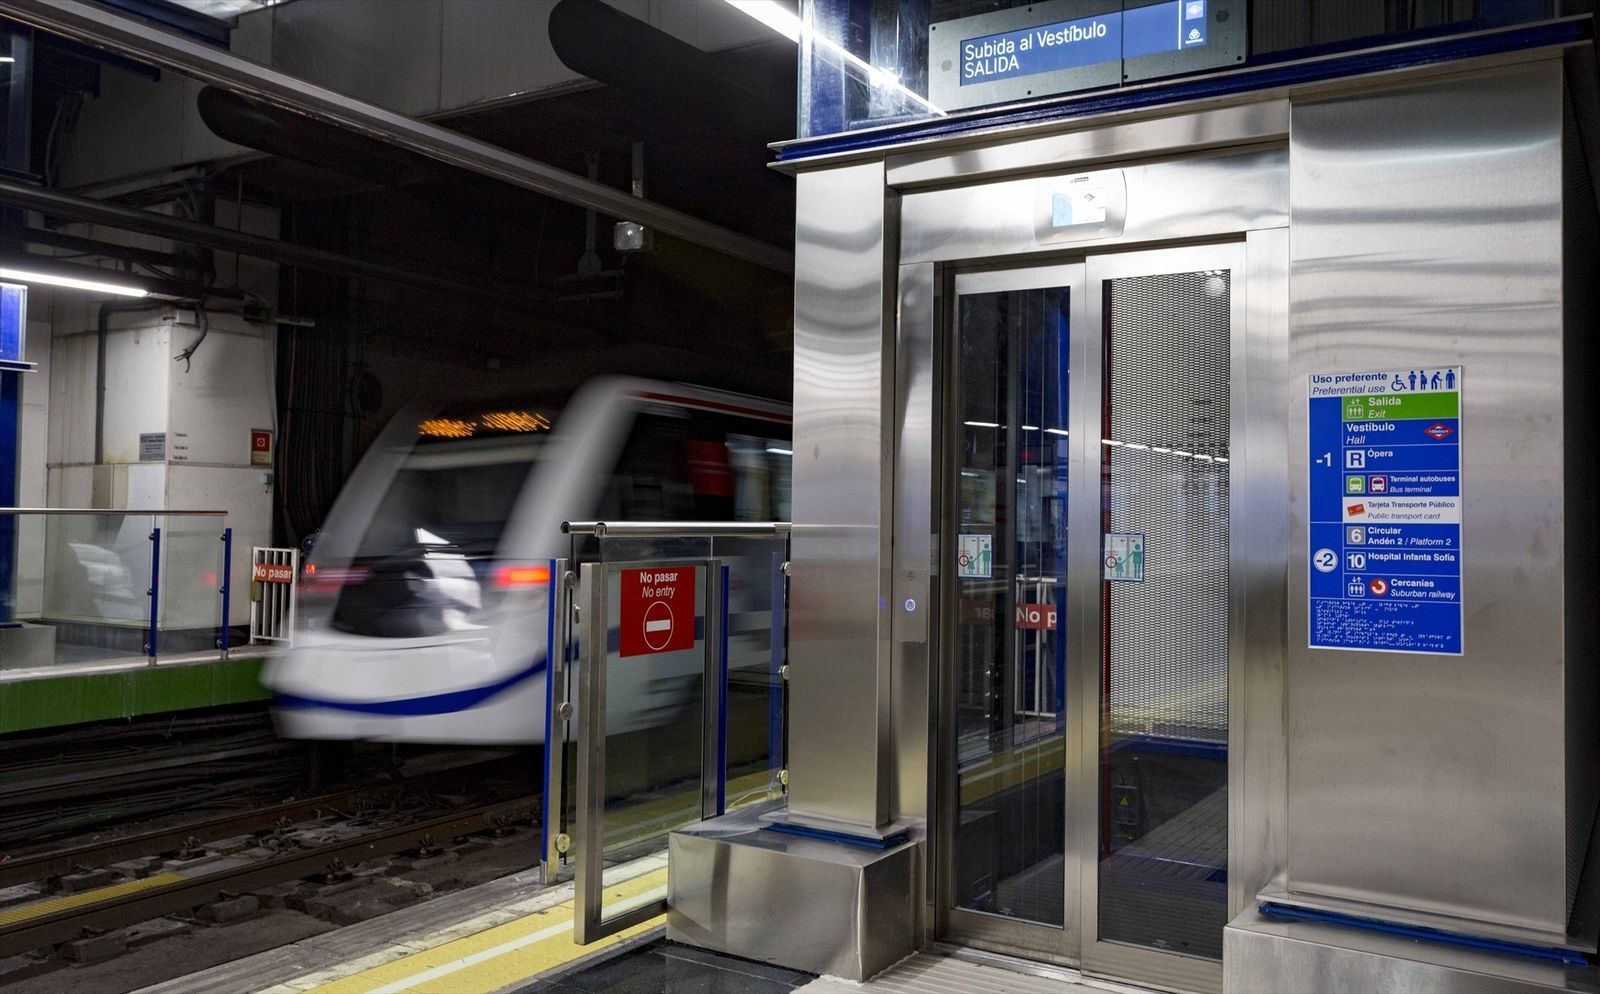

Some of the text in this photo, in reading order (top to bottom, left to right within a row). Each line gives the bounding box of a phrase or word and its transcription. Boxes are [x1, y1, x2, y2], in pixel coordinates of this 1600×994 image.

[964, 21, 1106, 61] Subida al Vestíbulo
[964, 55, 1019, 78] SALIDA
[1313, 373, 1388, 385] Uso preferente
[1312, 385, 1366, 396] Preferential
[1368, 397, 1402, 406] Salida
[1368, 410, 1386, 418] Exit
[1346, 422, 1395, 432] Vestíbulo
[1346, 435, 1366, 444] Hall
[1367, 448, 1394, 458] Ópera
[1316, 452, 1332, 467] -1
[1350, 452, 1362, 466] R
[1390, 475, 1418, 483] Terminal
[1368, 501, 1390, 509] Tarjeta
[1391, 501, 1427, 509] Transporte
[1351, 529, 1362, 542] 6
[1367, 537, 1396, 545] Andén
[1316, 553, 1334, 567] -2
[1347, 554, 1365, 568] 10
[1368, 552, 1455, 561] Hospital Infanta Sofía
[255, 566, 292, 580] No pasar
[640, 572, 678, 585] No pasar
[1391, 579, 1434, 588] Cercanías
[642, 586, 676, 599] No entry
[1391, 589, 1455, 600] Suburban railway
[1016, 607, 1041, 623] No
